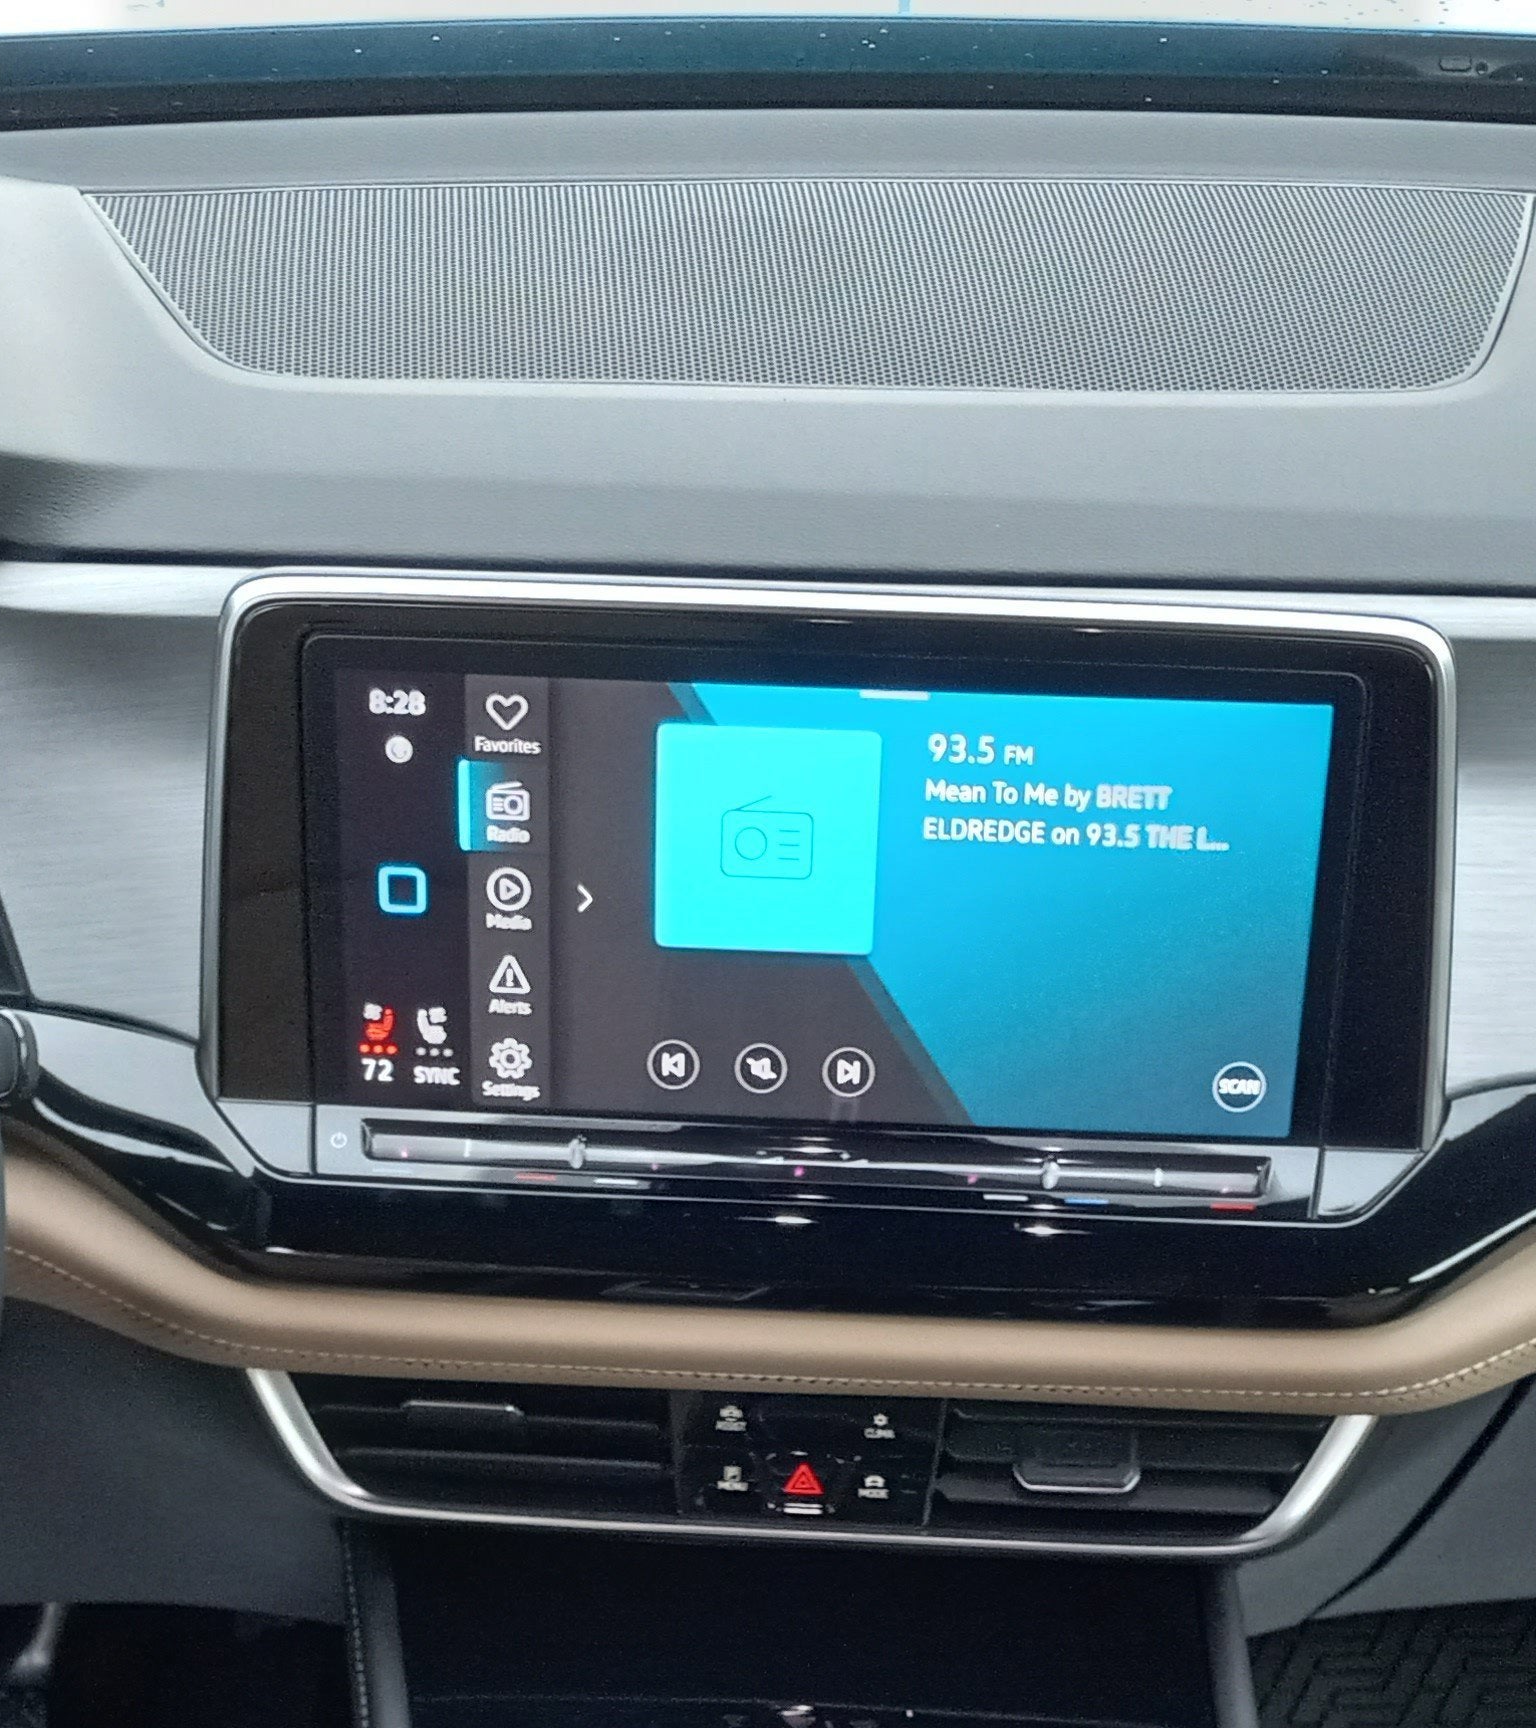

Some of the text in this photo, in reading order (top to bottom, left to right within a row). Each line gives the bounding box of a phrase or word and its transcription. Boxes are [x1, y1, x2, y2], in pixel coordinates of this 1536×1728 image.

[368, 687, 427, 717] 8:28
[474, 735, 542, 755] Favorites
[927, 733, 1034, 765] 93.5 FM
[925, 779, 1172, 812] Mean To Me by BRETT
[486, 825, 531, 843] Radio
[923, 816, 1045, 844] ELDREDGE
[1051, 827, 1080, 846] on
[1085, 823, 1140, 848] 93.5
[1146, 824, 1192, 849] THE
[486, 914, 532, 931] Media
[489, 999, 532, 1016] Alerts
[361, 1058, 394, 1082] 72
[413, 1065, 461, 1086] SYNC
[482, 1080, 541, 1102] Settings
[1219, 1078, 1261, 1095] SCAN
